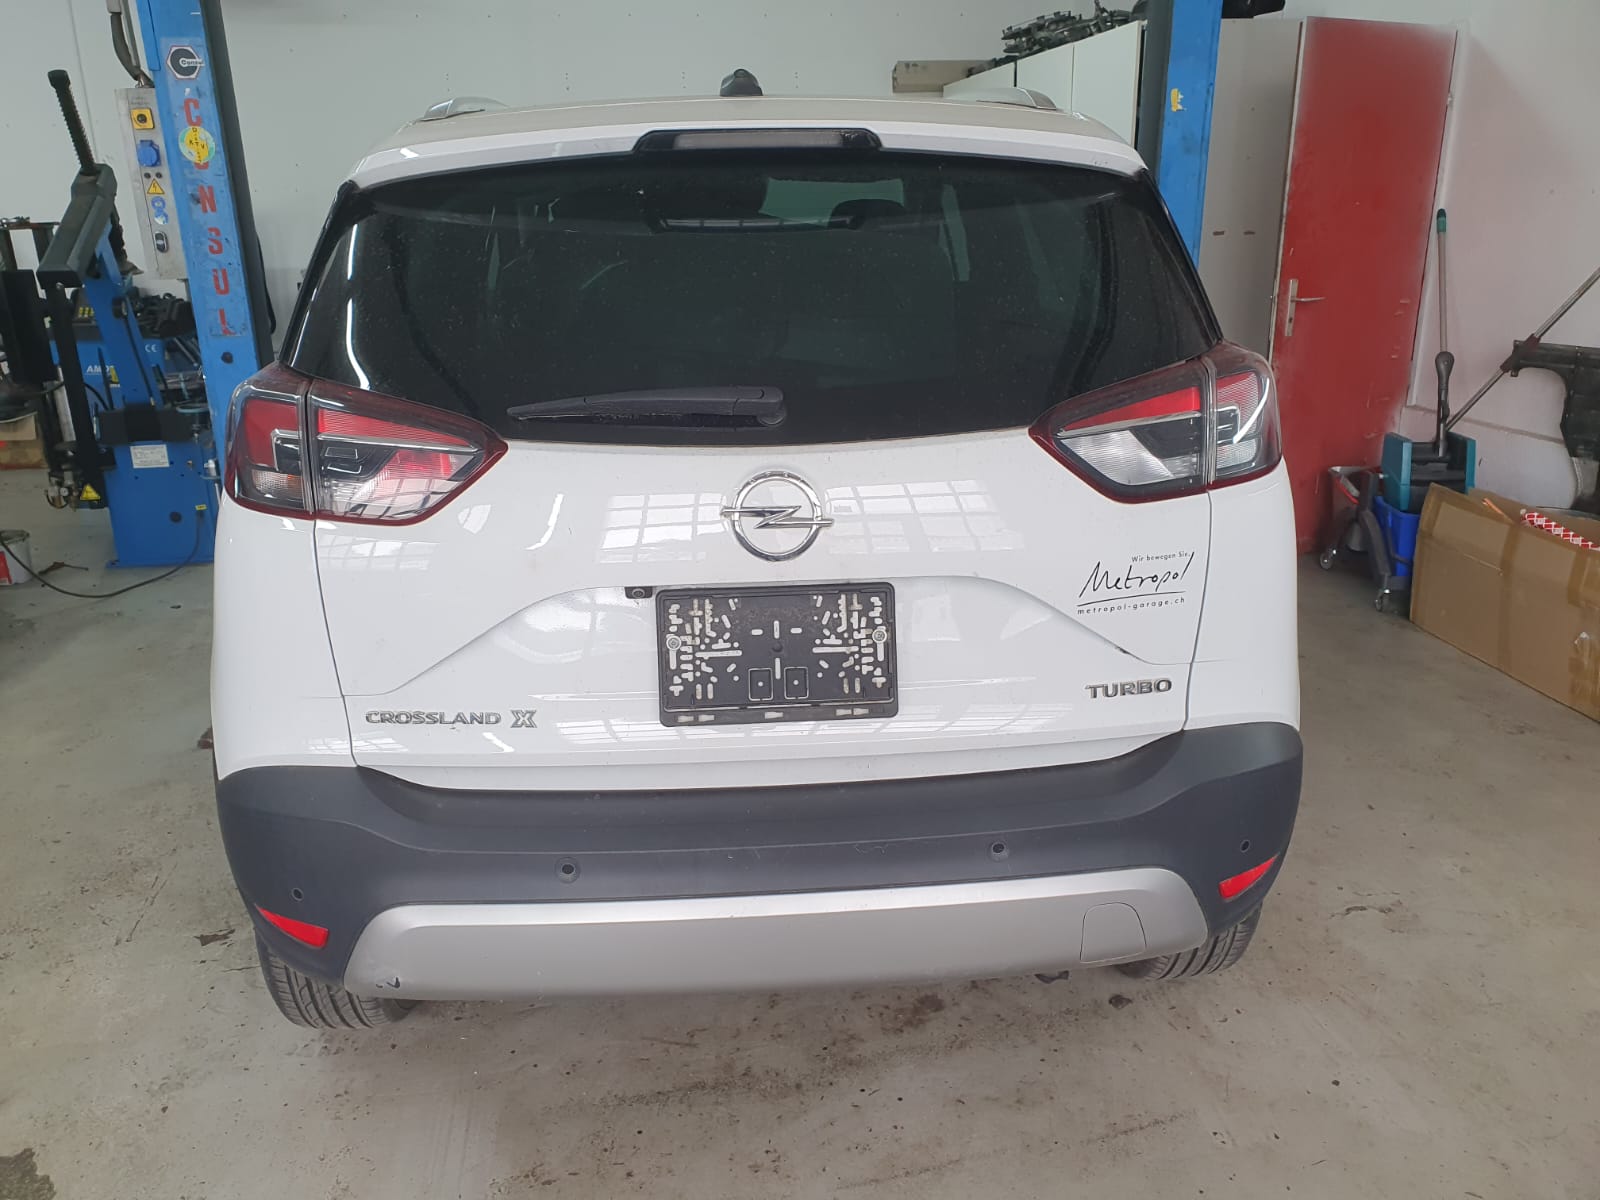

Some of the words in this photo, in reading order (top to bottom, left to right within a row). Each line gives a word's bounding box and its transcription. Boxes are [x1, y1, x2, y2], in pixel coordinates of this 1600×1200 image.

[184, 98, 237, 336] CNSUL
[1079, 552, 1195, 598] Metropol
[1077, 597, 1185, 616] metropol-garage.ch
[1085, 678, 1172, 698] TURBO
[366, 711, 501, 725] CROSSLAND
[510, 709, 537, 728] X
